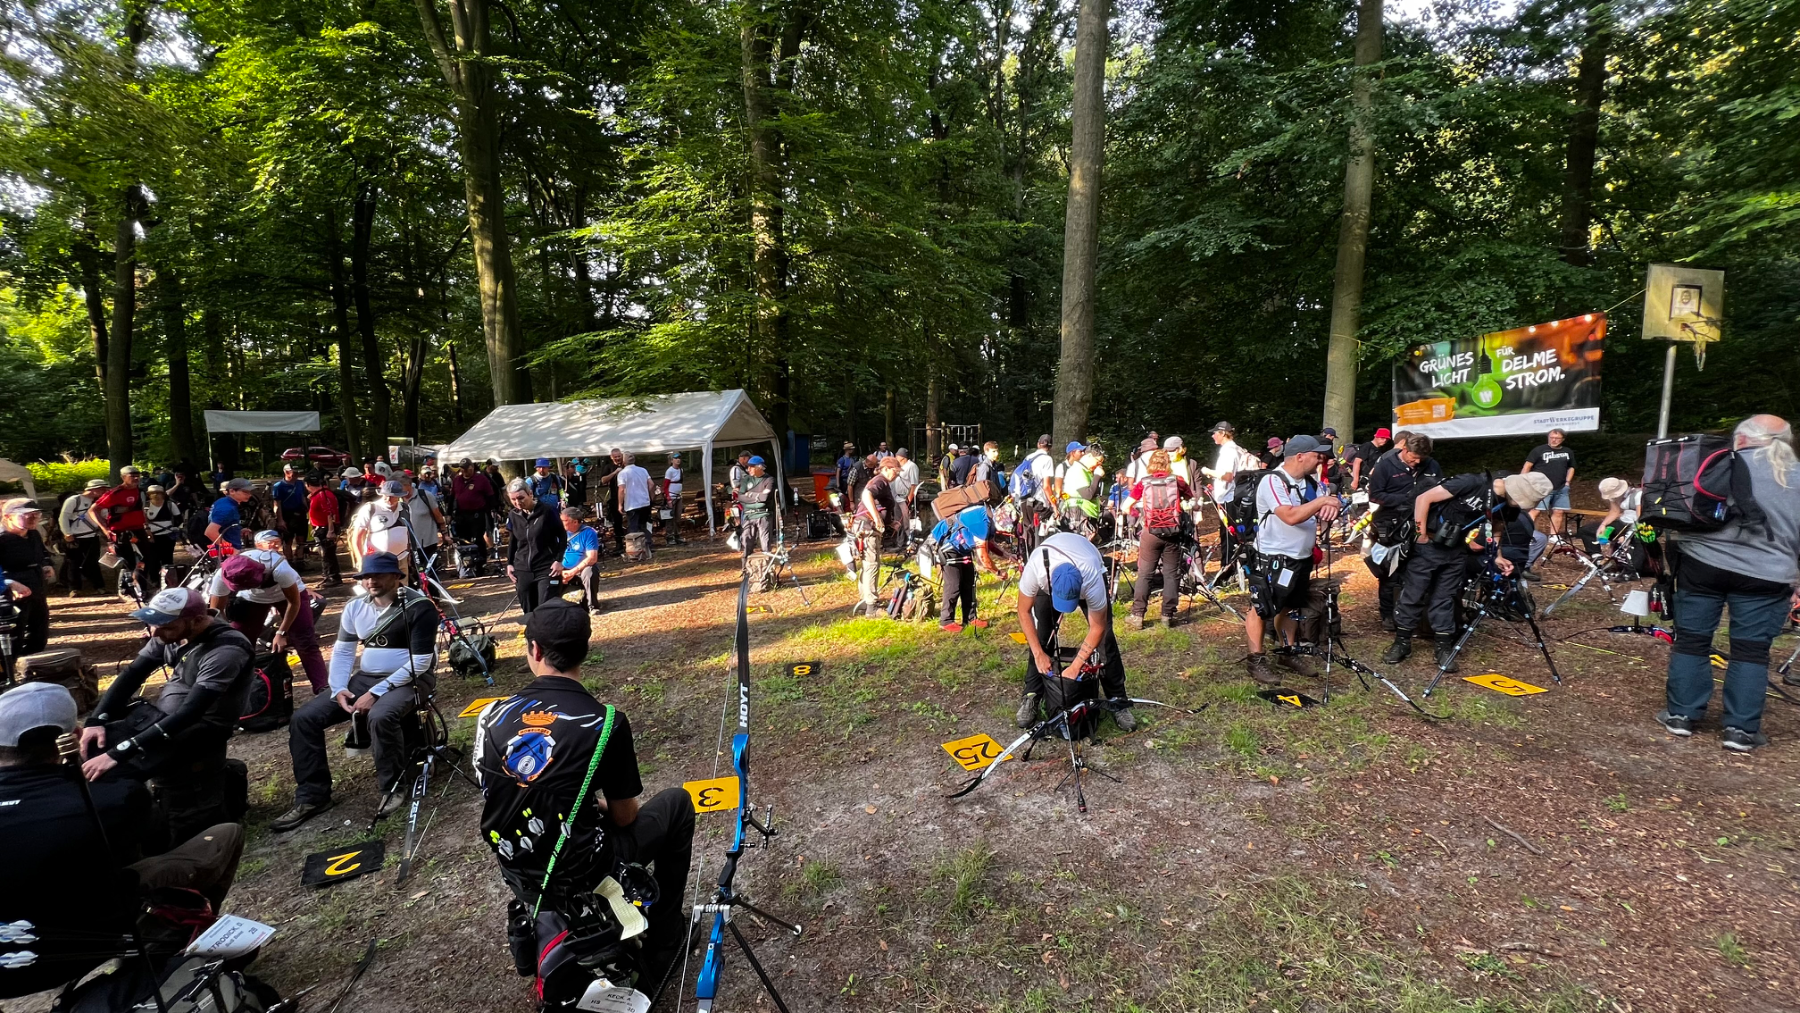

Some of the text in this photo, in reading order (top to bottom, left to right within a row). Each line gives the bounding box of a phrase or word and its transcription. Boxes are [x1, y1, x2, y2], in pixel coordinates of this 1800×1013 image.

[1419, 351, 1474, 373] GRÜNES
[1496, 346, 1515, 358] FÜR
[1502, 349, 1558, 373] DELME
[1431, 368, 1471, 388] LICHT
[1505, 366, 1566, 390] STROM.
[1543, 451, 1570, 463] Gibson
[793, 665, 811, 675] 8
[1490, 680, 1527, 693] 5
[739, 682, 749, 728] HOYT
[953, 740, 1004, 767] 25
[698, 787, 724, 807] 3
[324, 849, 363, 876] 2
